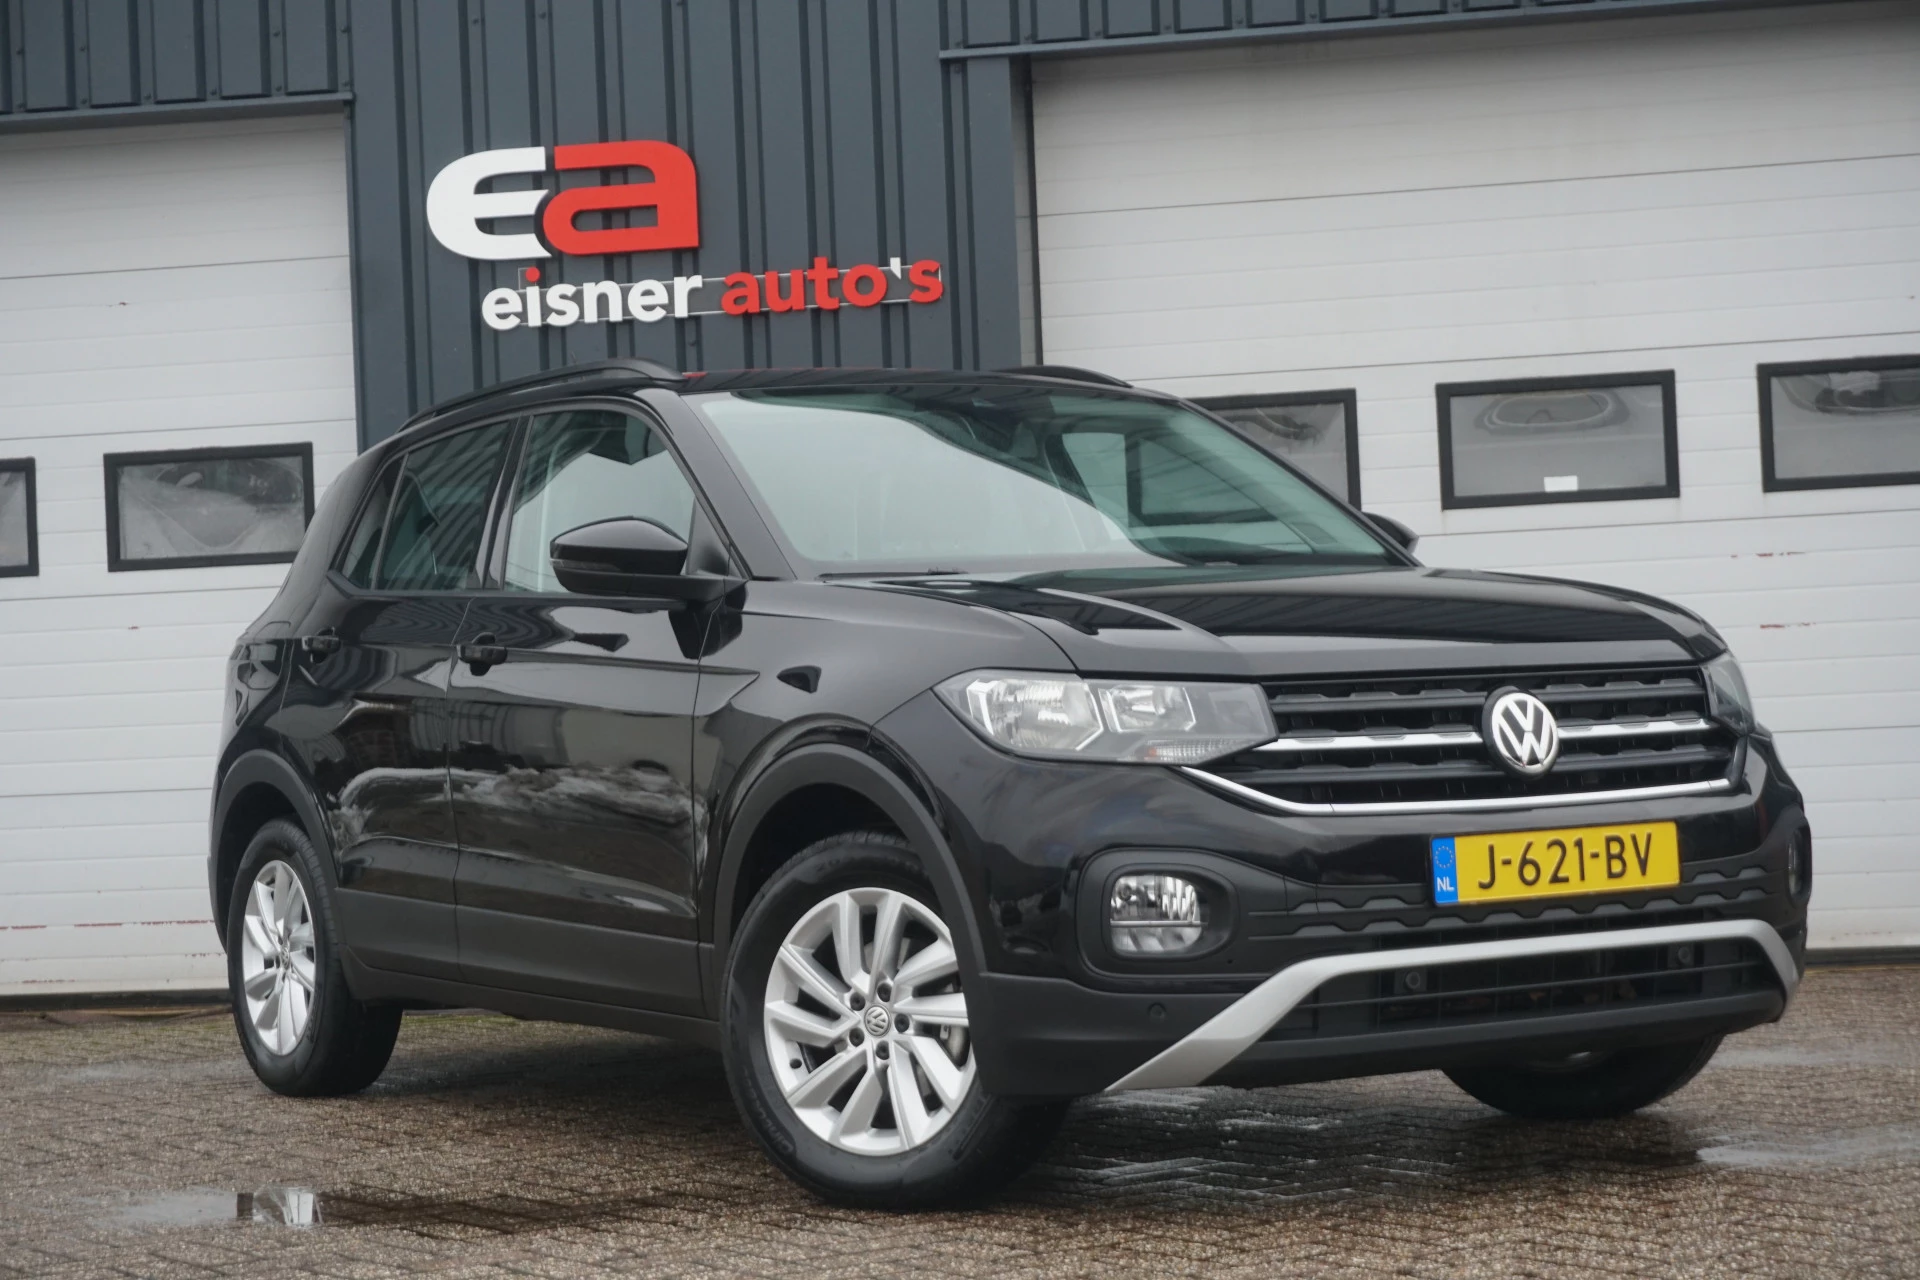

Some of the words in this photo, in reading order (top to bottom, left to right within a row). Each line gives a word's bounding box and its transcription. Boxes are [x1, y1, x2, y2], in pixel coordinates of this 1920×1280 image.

[426, 139, 700, 260] ea
[481, 266, 703, 331] eisner
[720, 256, 944, 316] auto's
[1436, 876, 1455, 892] NL
[1477, 831, 1653, 890] J-621-BV
